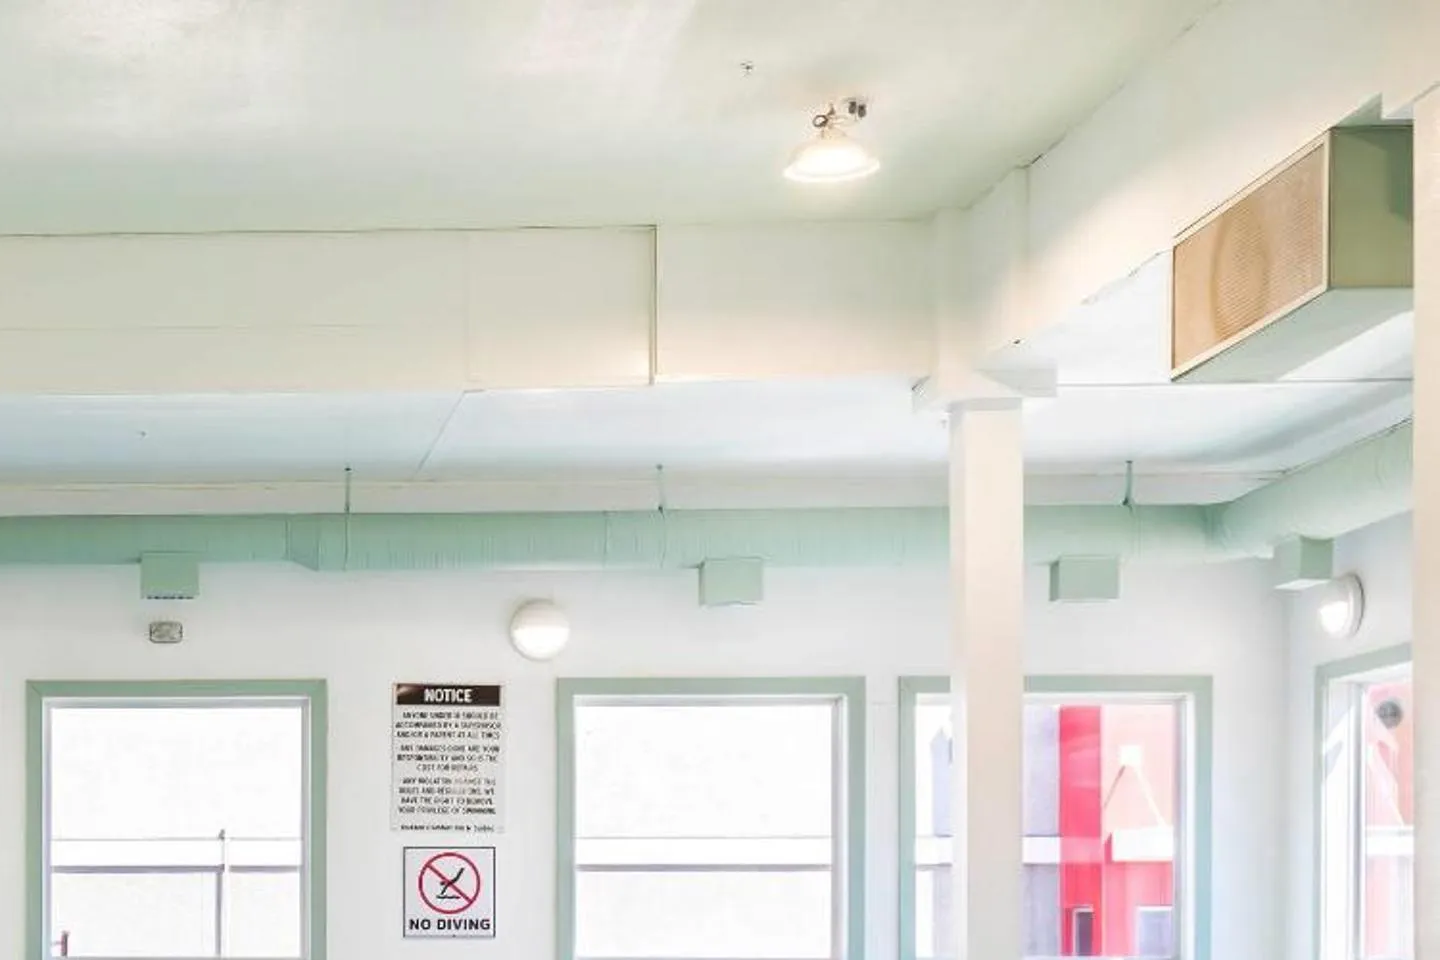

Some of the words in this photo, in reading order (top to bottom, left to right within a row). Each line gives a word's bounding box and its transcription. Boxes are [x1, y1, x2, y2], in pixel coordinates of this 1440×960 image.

[423, 688, 473, 703] NOTICE
[409, 918, 431, 931] NO
[436, 918, 491, 931] DIVING
